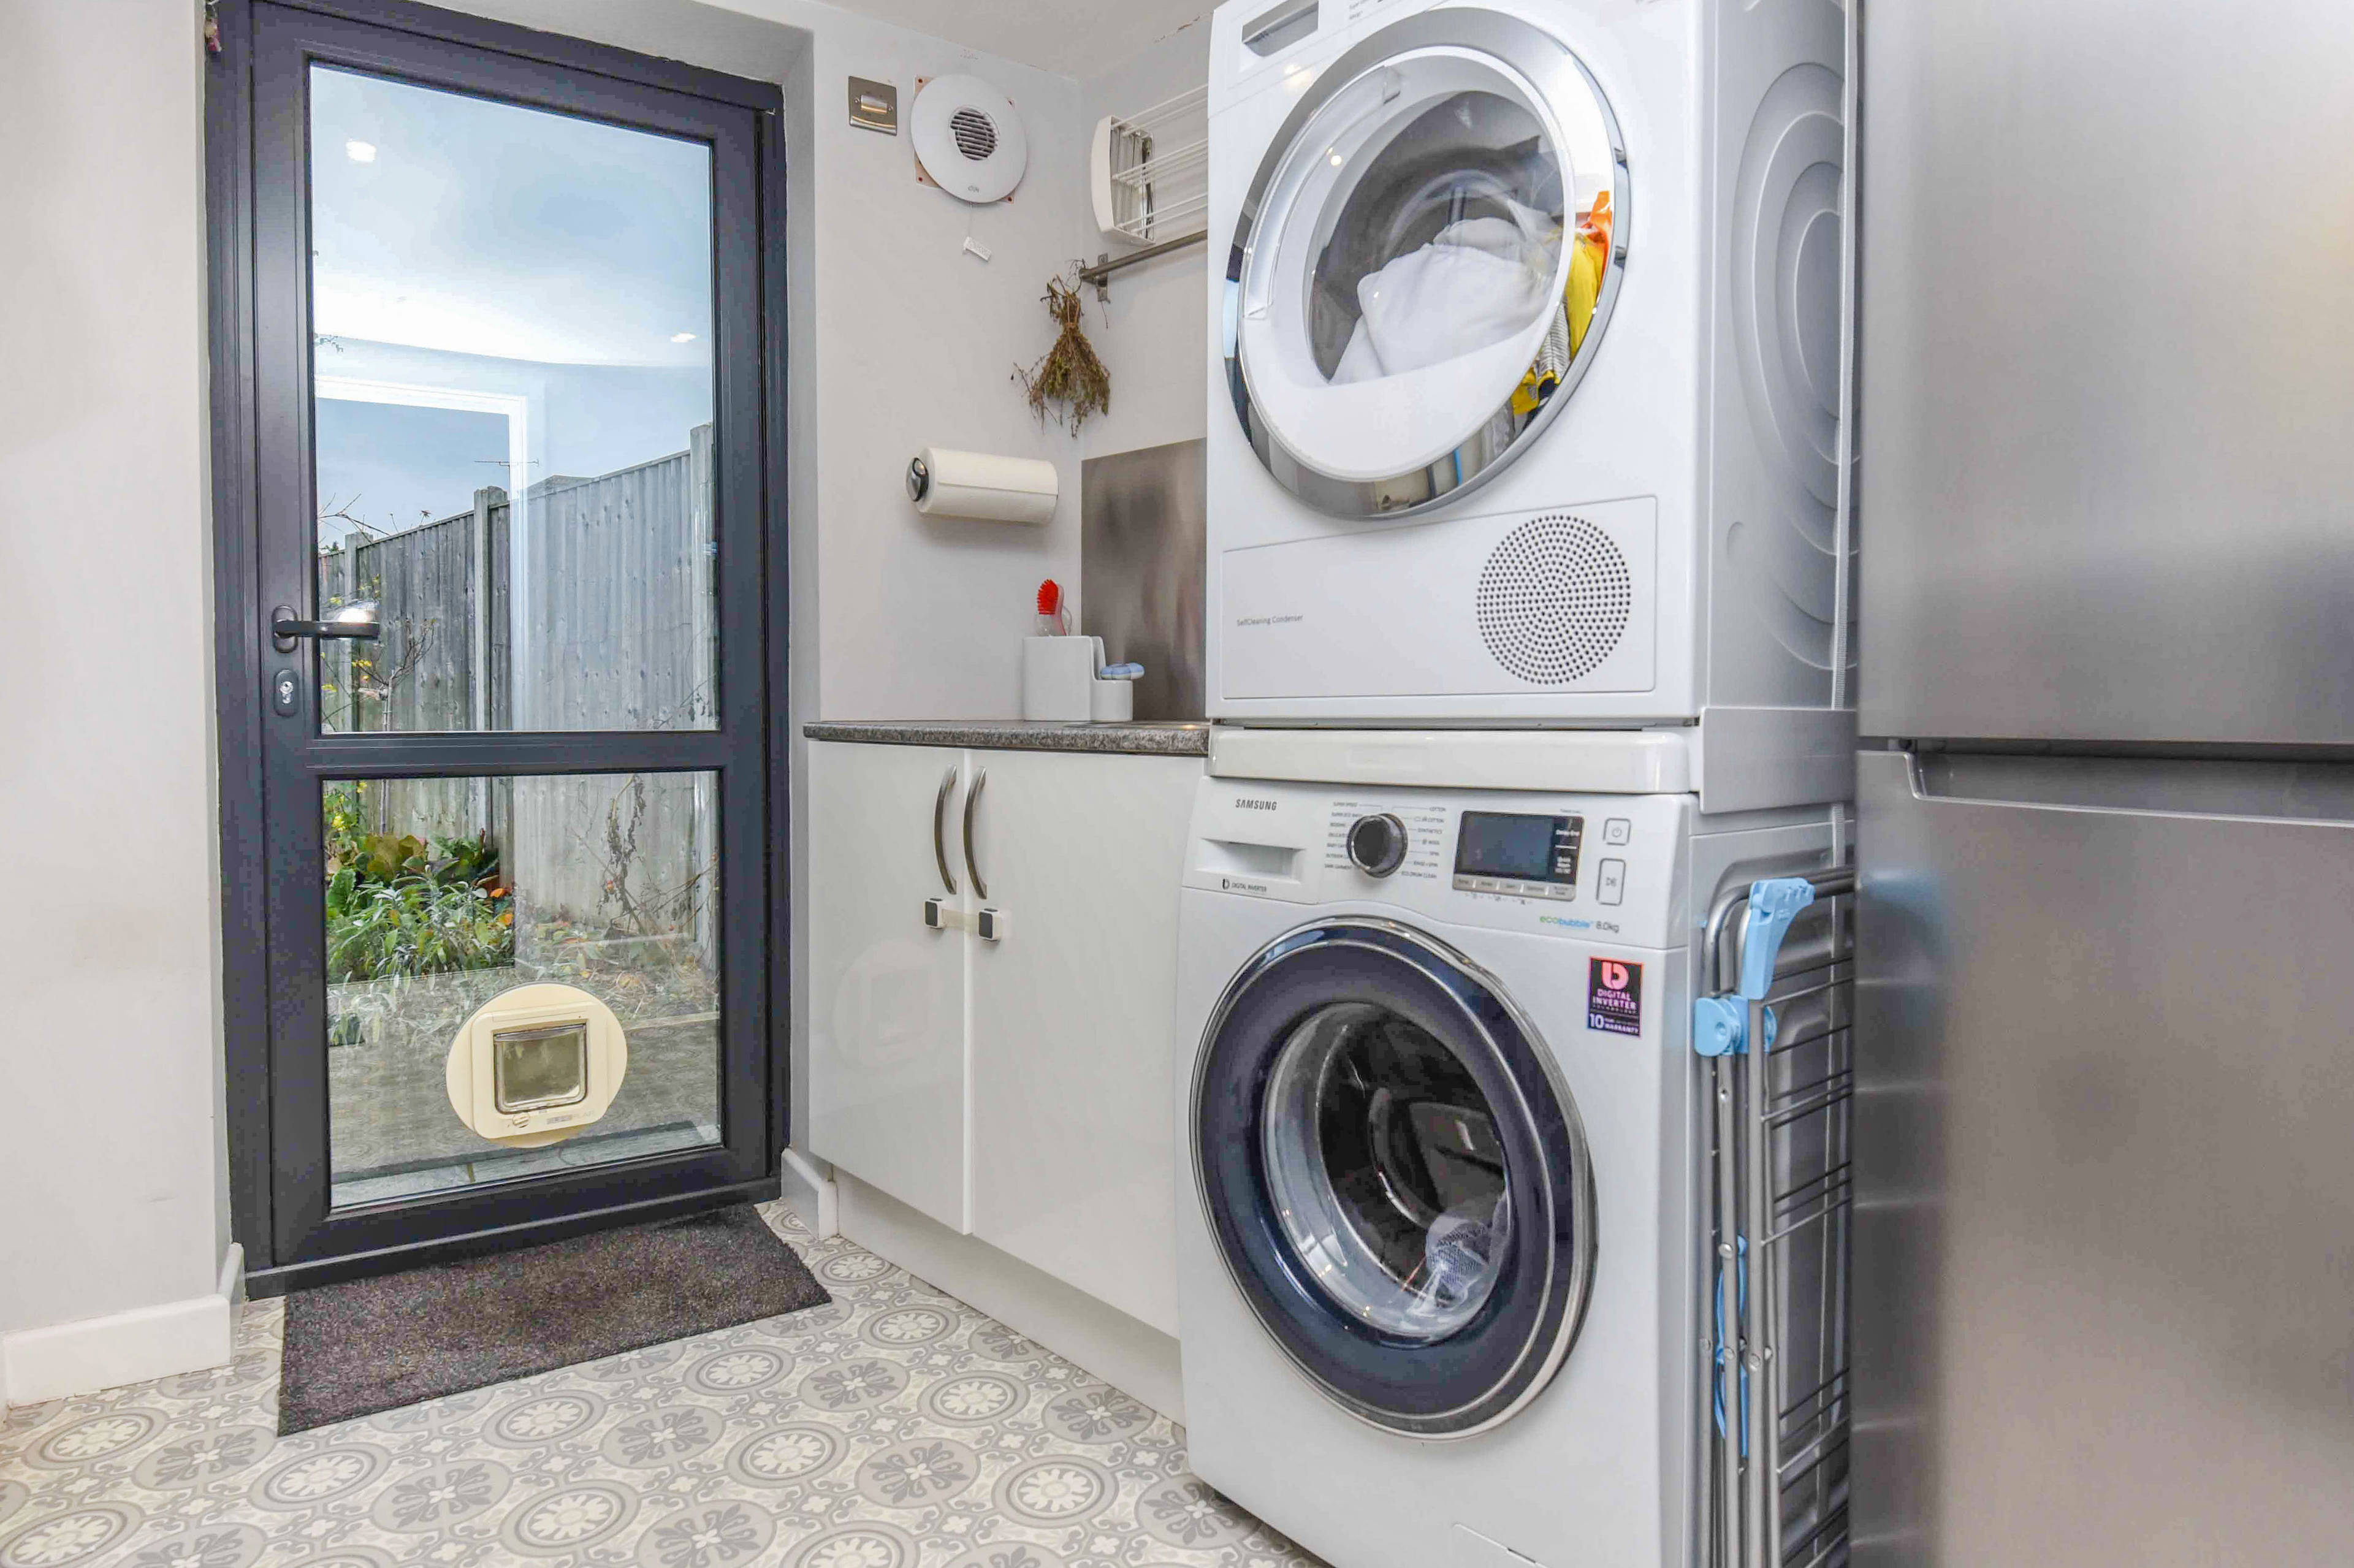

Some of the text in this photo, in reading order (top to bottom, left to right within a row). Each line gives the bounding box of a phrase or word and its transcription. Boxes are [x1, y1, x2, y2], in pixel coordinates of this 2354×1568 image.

[1272, 614, 1303, 623] Condenser
[1235, 799, 1278, 811] SAMSUNG
[1539, 916, 1620, 934] ecobubble 8.0kg
[1597, 988, 1631, 1001] DIGITAL
[1592, 995, 1637, 1010] INVERTER
[1590, 1013, 1604, 1029] 10
[1605, 1023, 1639, 1033] WARRANTY
